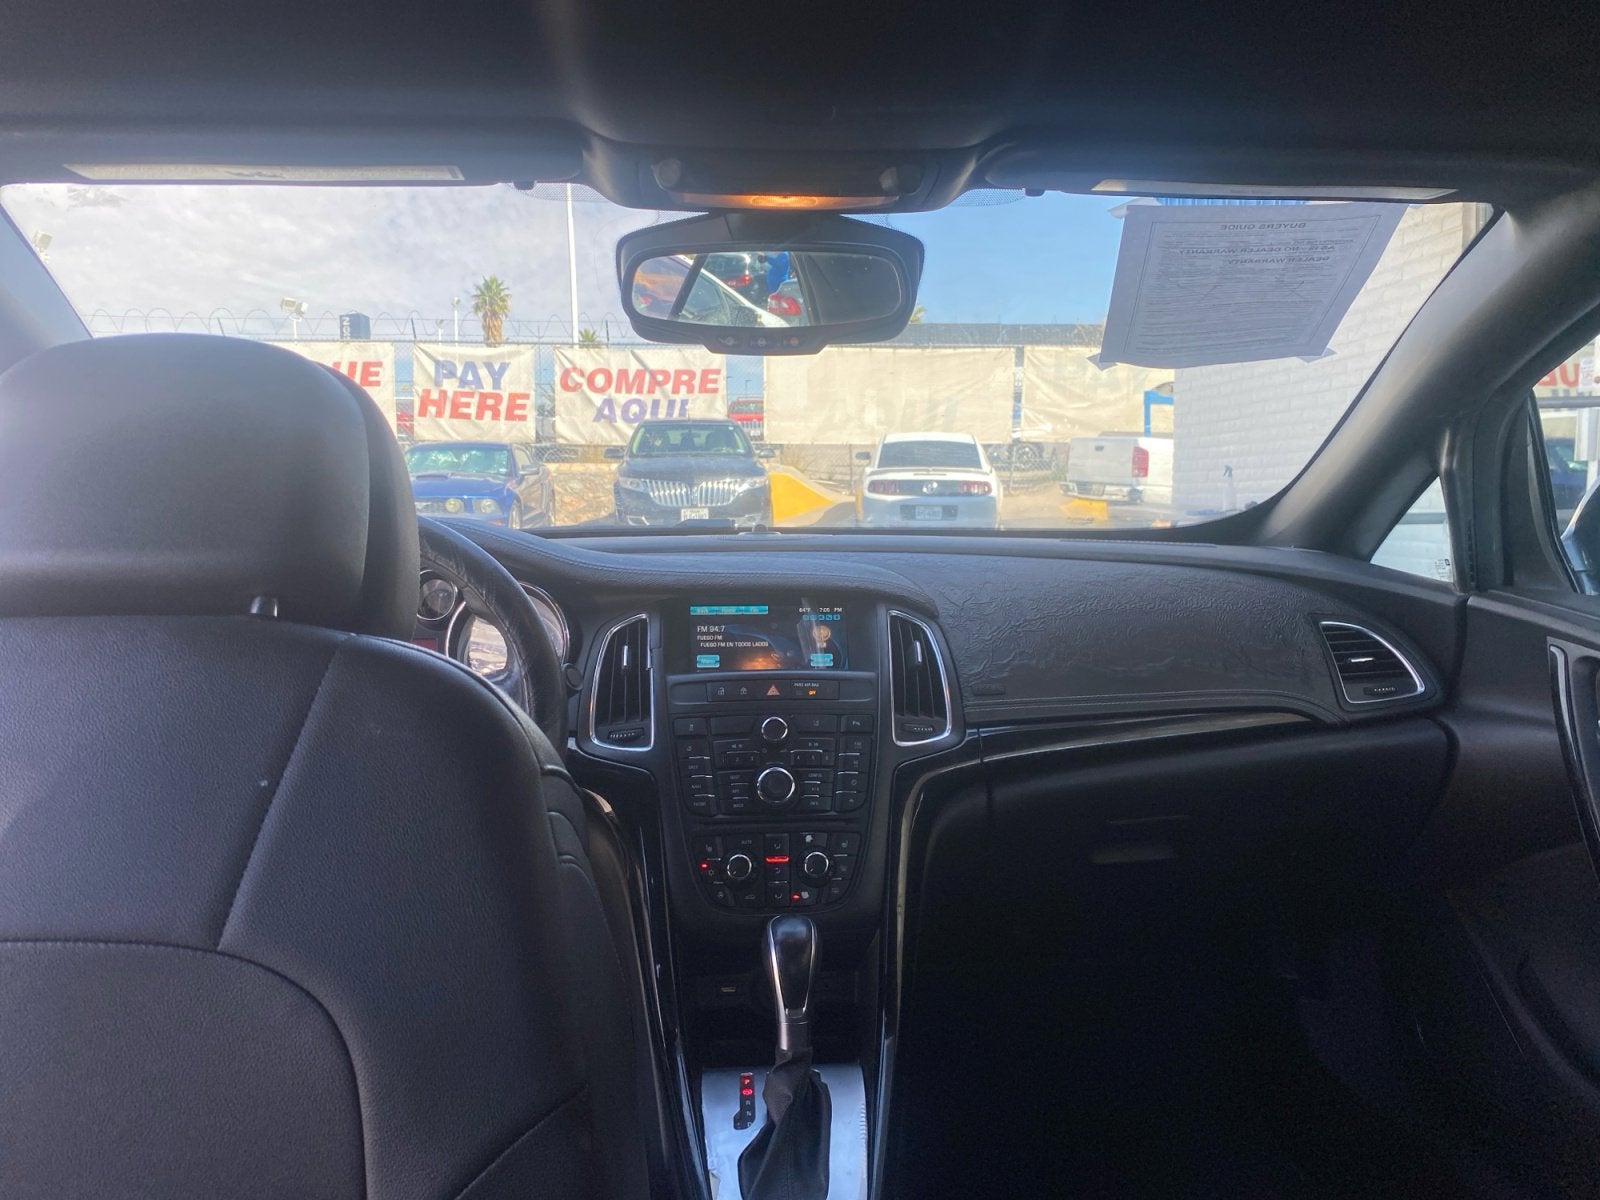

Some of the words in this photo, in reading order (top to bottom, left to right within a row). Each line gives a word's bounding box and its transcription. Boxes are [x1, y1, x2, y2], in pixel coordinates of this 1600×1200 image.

[433, 359, 511, 390] PAY
[559, 366, 722, 395] COMPRE
[417, 388, 531, 422] HERE
[697, 625, 708, 633] FM
[709, 625, 725, 633] 94.7
